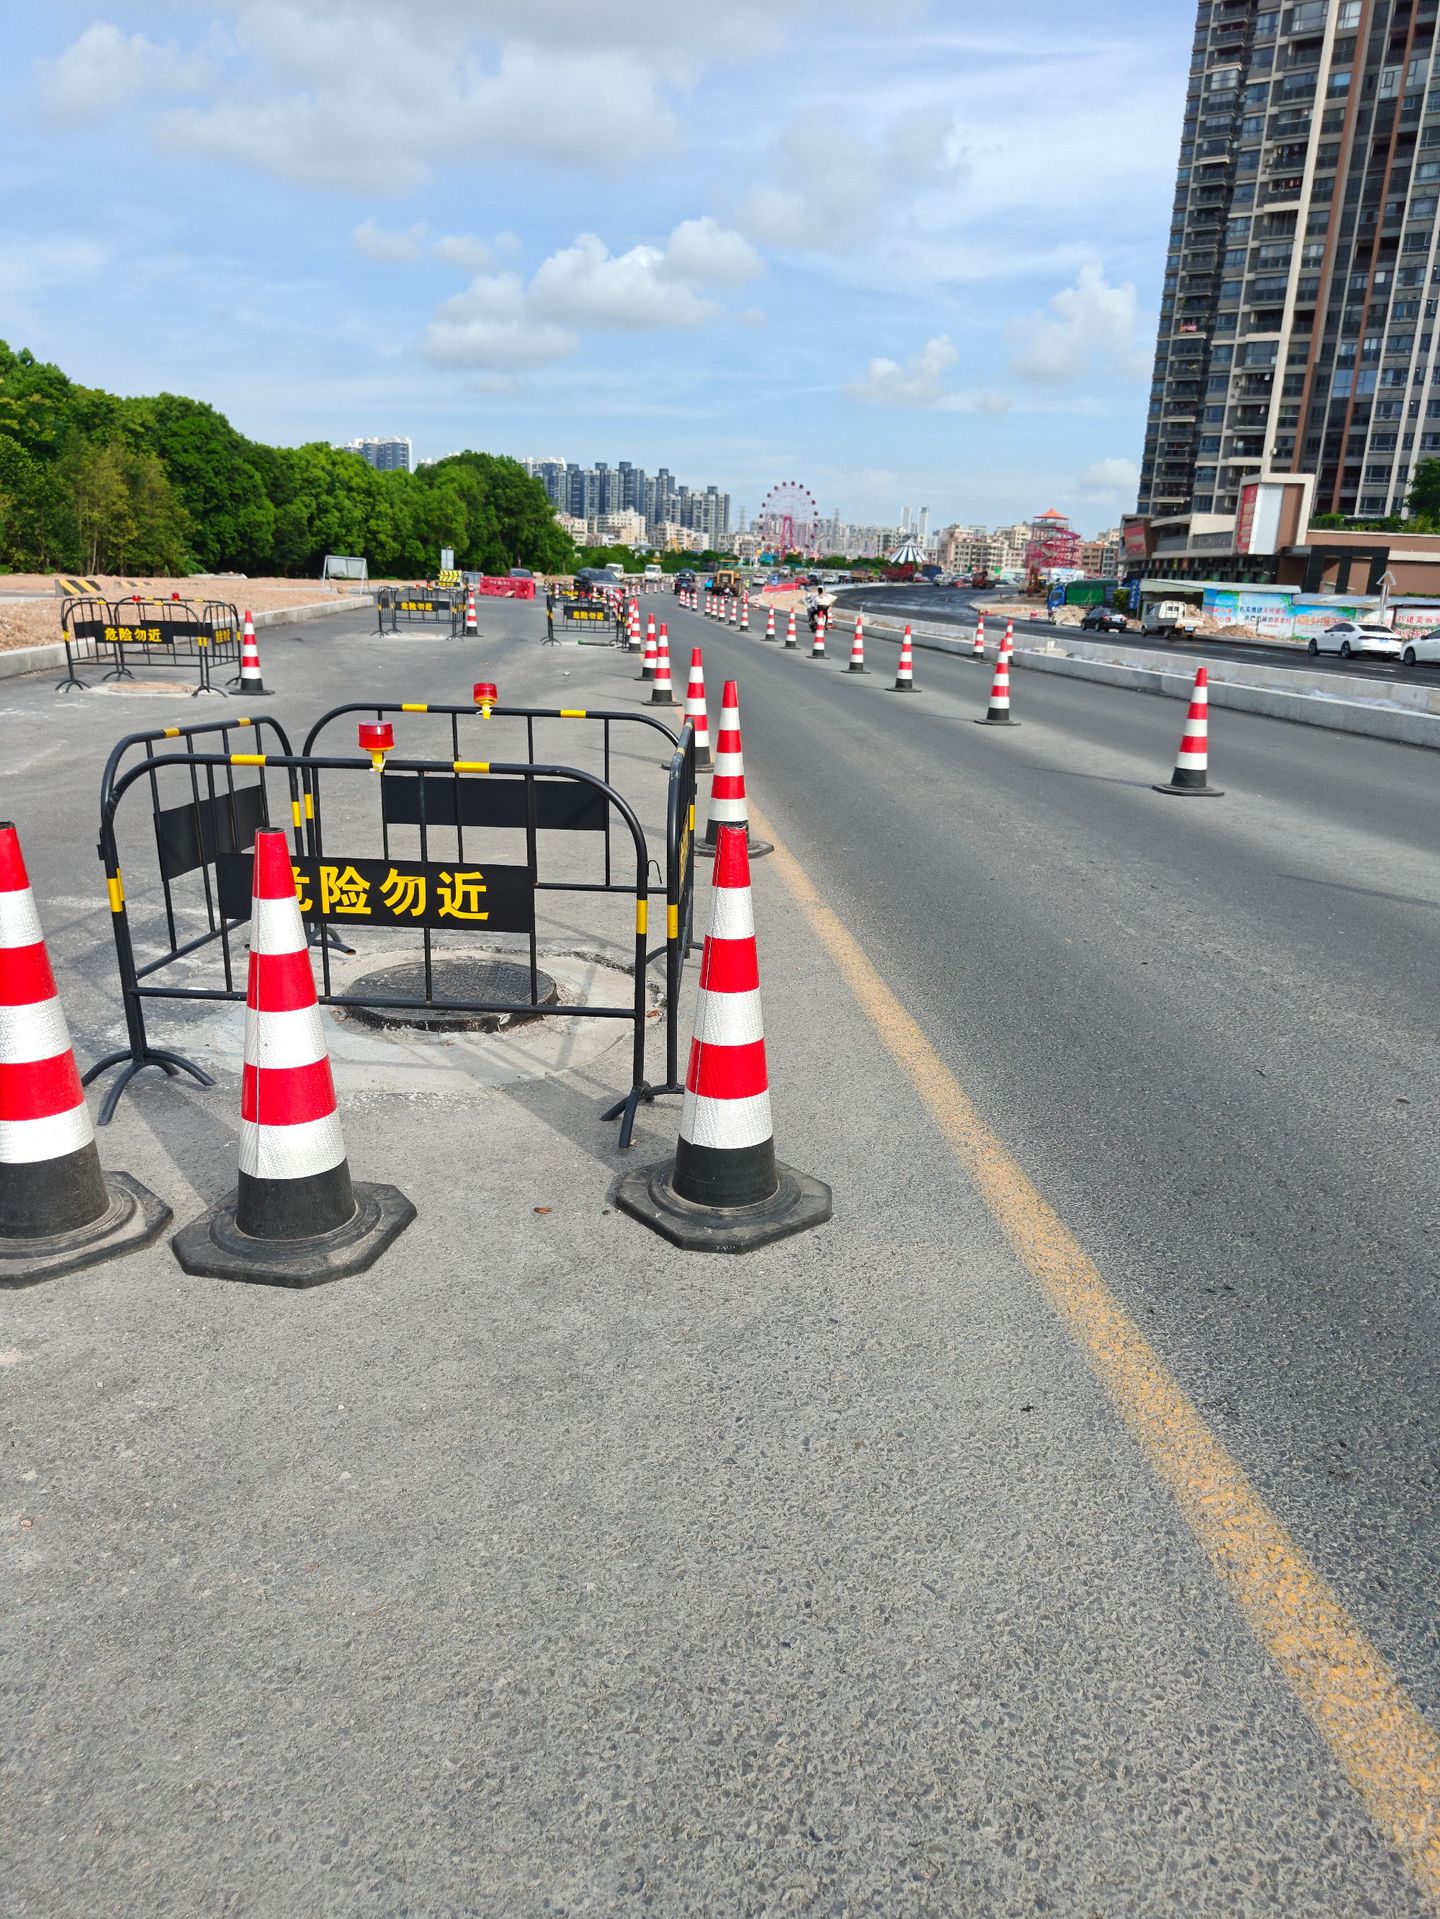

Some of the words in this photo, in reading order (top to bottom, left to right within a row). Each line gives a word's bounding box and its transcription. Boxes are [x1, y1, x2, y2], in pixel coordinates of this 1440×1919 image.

[400, 601, 433, 611] 危险勿近
[572, 610, 605, 621] 危险勿近
[104, 626, 163, 643] 危险勿近
